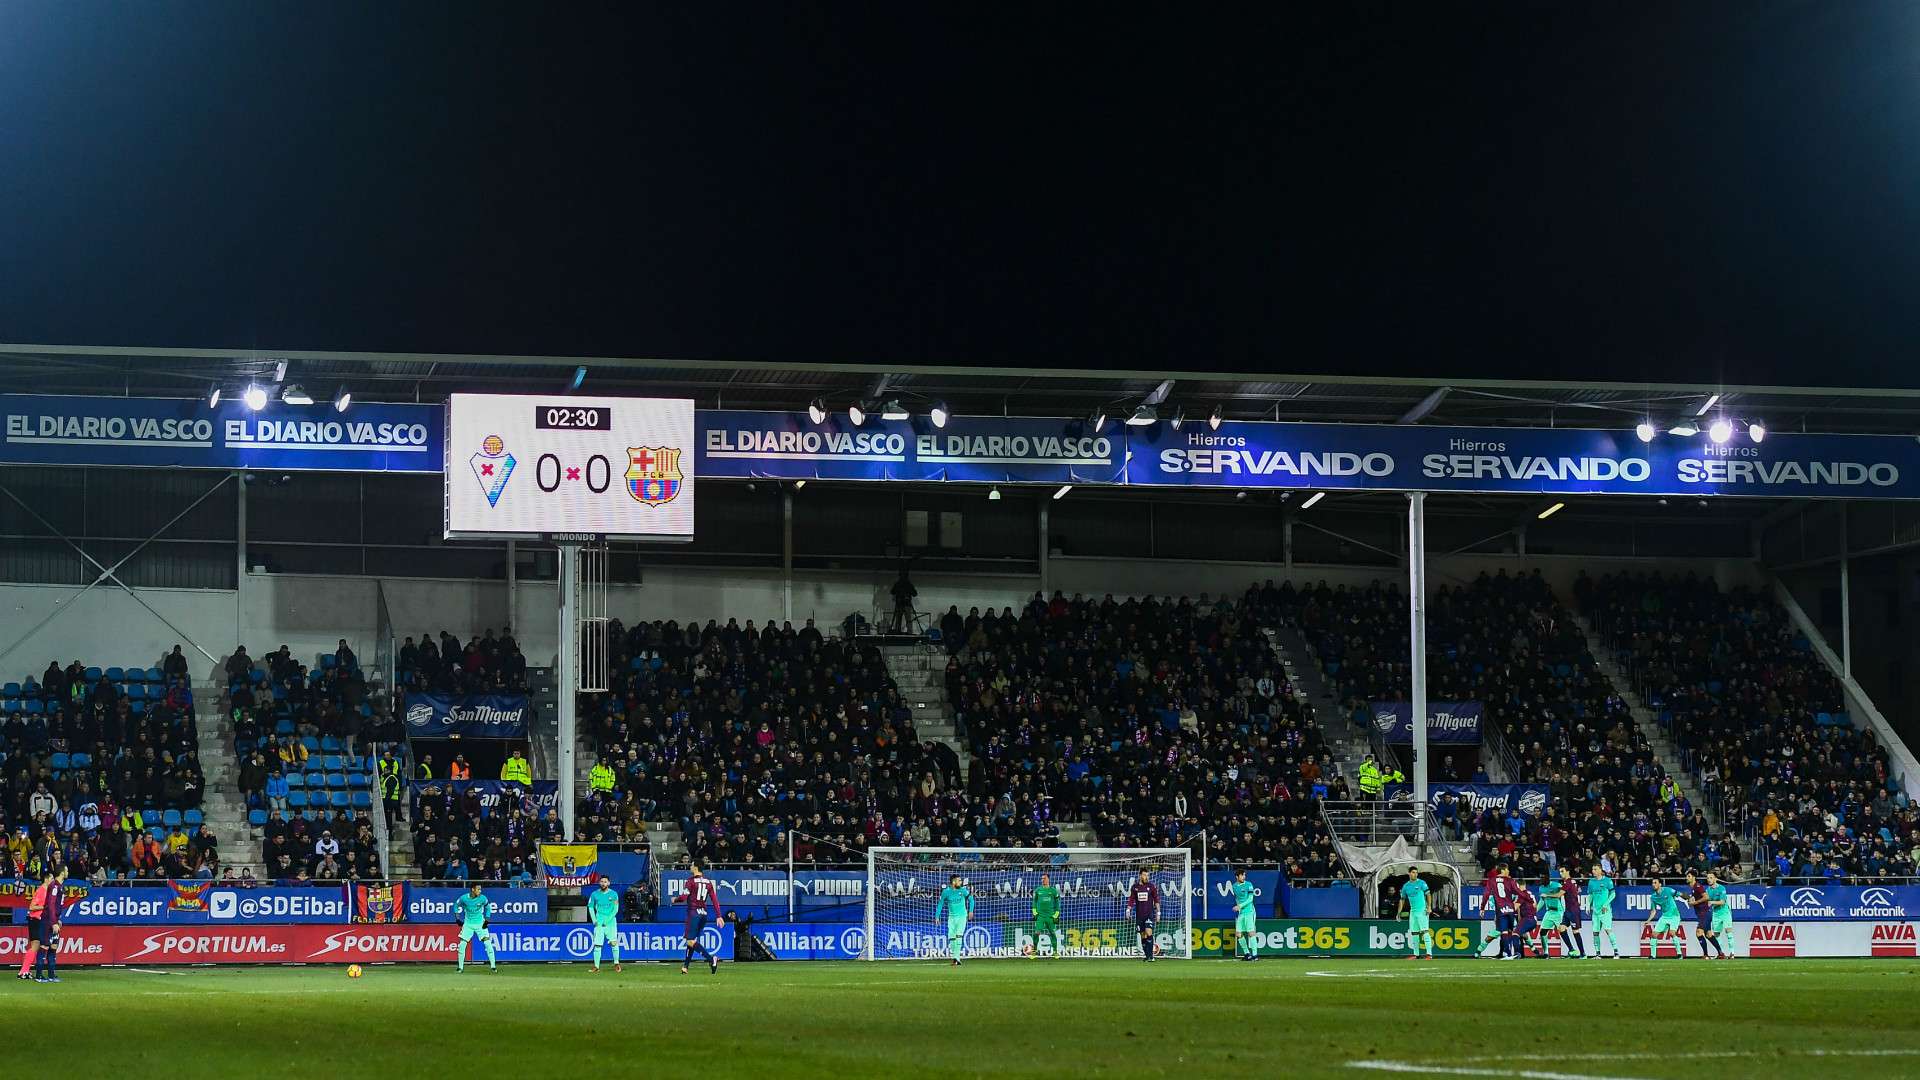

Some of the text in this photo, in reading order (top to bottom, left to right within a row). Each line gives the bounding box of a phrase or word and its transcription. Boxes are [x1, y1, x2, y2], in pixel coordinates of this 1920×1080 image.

[7, 415, 213, 440] EL DIARIO VASCO
[547, 409, 599, 427] 02:30
[225, 420, 428, 445] EL DIARIO VASCO
[1188, 433, 1246, 447] Hierros
[707, 430, 905, 455] EL DIARIO VASCO
[917, 435, 1111, 458] EL DIARIO VASCO
[1450, 438, 1506, 452] Hierros
[1704, 443, 1759, 457] Hierros
[1160, 448, 1395, 477] SERVANDO
[1423, 454, 1651, 482] SERVANDO
[536, 453, 611, 494] 0 0
[1678, 459, 1899, 487] SERVANDO
[559, 533, 596, 541] MONDO
[549, 877, 591, 886] YAGUACHI
[668, 880, 717, 896] PUA
[742, 880, 789, 896] PUMA
[815, 880, 862, 896] PUMA
[995, 878, 1036, 898] Wik
[1055, 878, 1100, 898] Wiko
[1161, 877, 1206, 897] Wko
[239, 897, 345, 918] @SDEibar
[1779, 906, 1835, 917] urkotronik
[1850, 906, 1906, 917] urkotronik
[1750, 922, 1796, 941] AVIA
[1872, 921, 1916, 940] AVIA
[125, 930, 286, 959] SPORTIUM.es
[486, 933, 561, 952] Allianz
[616, 932, 688, 951] Allianz
[763, 931, 835, 951] Allianz
[887, 931, 951, 951] Allian
